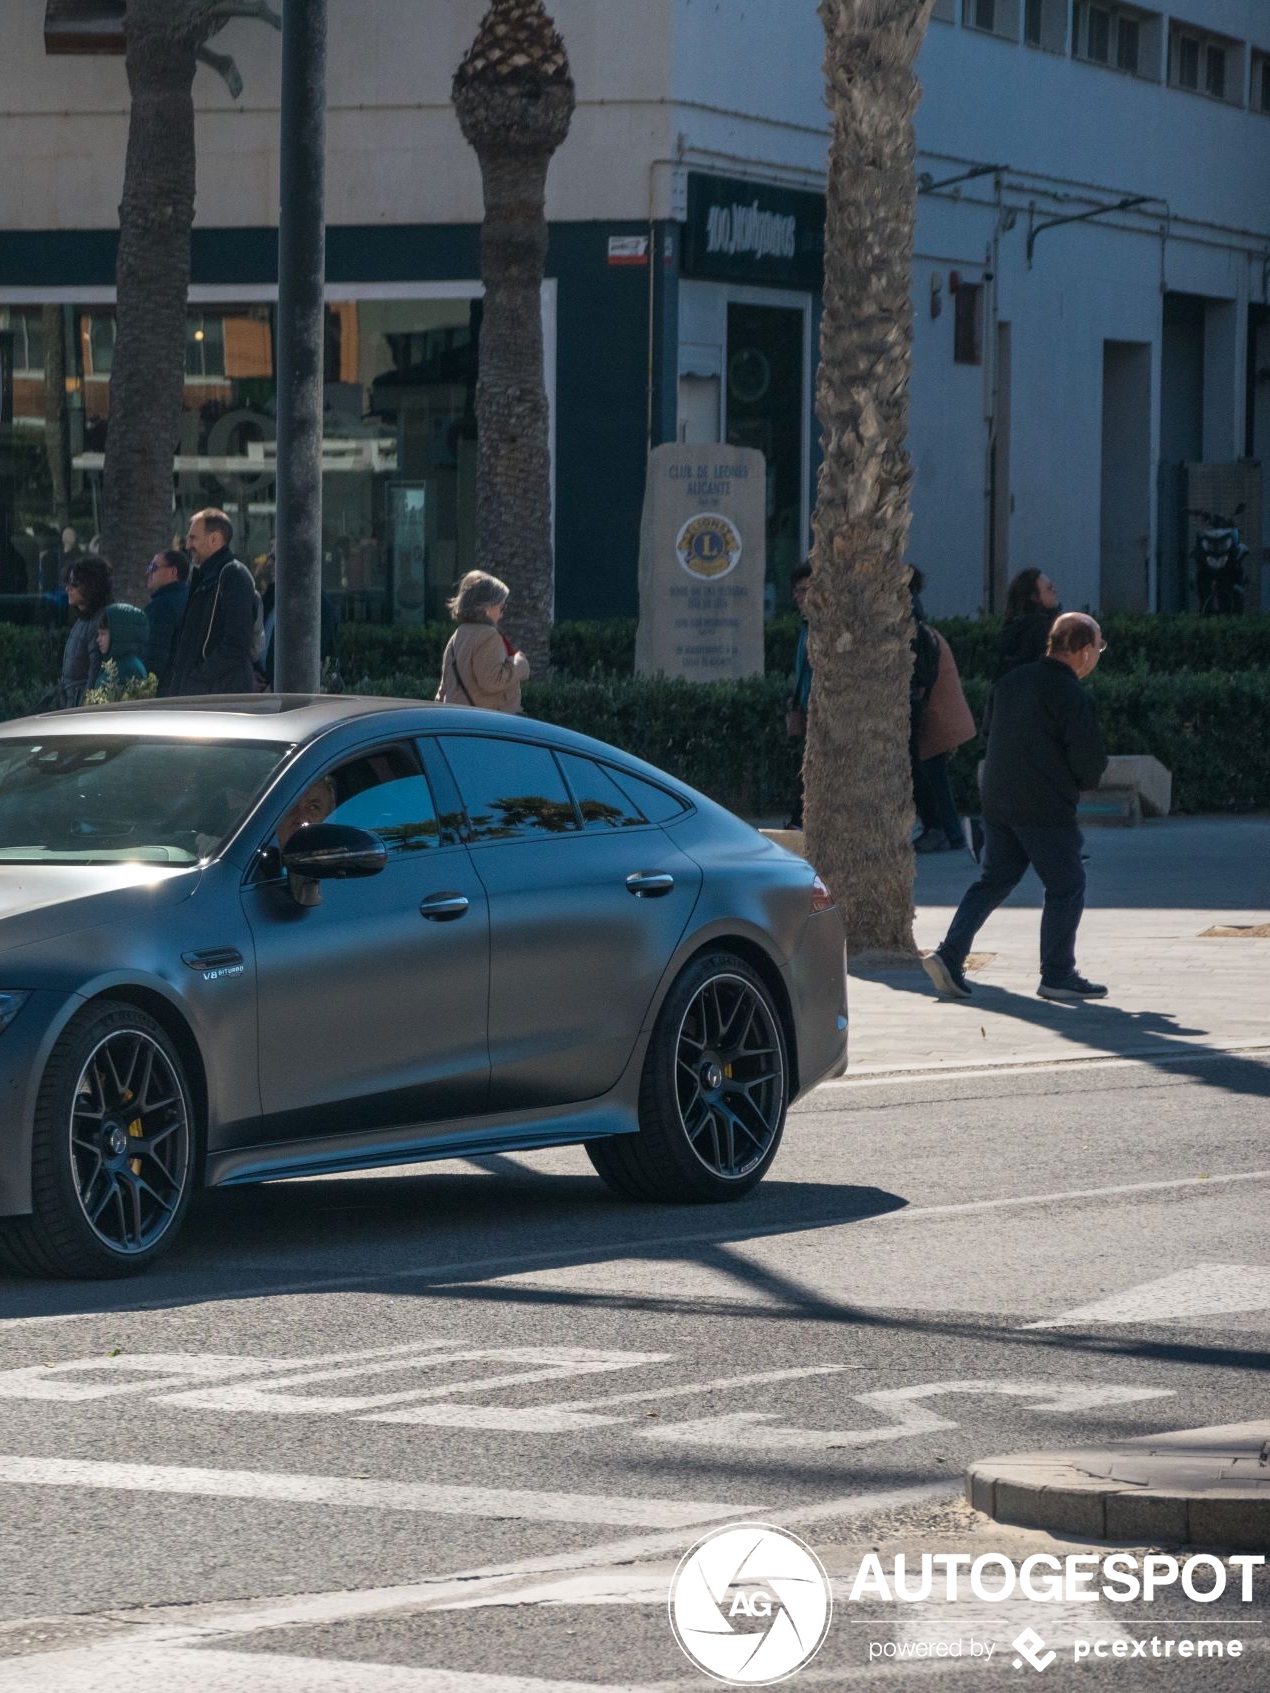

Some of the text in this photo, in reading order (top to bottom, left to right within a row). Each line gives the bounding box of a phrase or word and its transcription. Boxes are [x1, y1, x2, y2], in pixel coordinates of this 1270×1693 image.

[669, 463, 748, 480] CLUB DE LEONES
[687, 480, 731, 496] ALICANTE
[202, 971, 218, 981] V8
